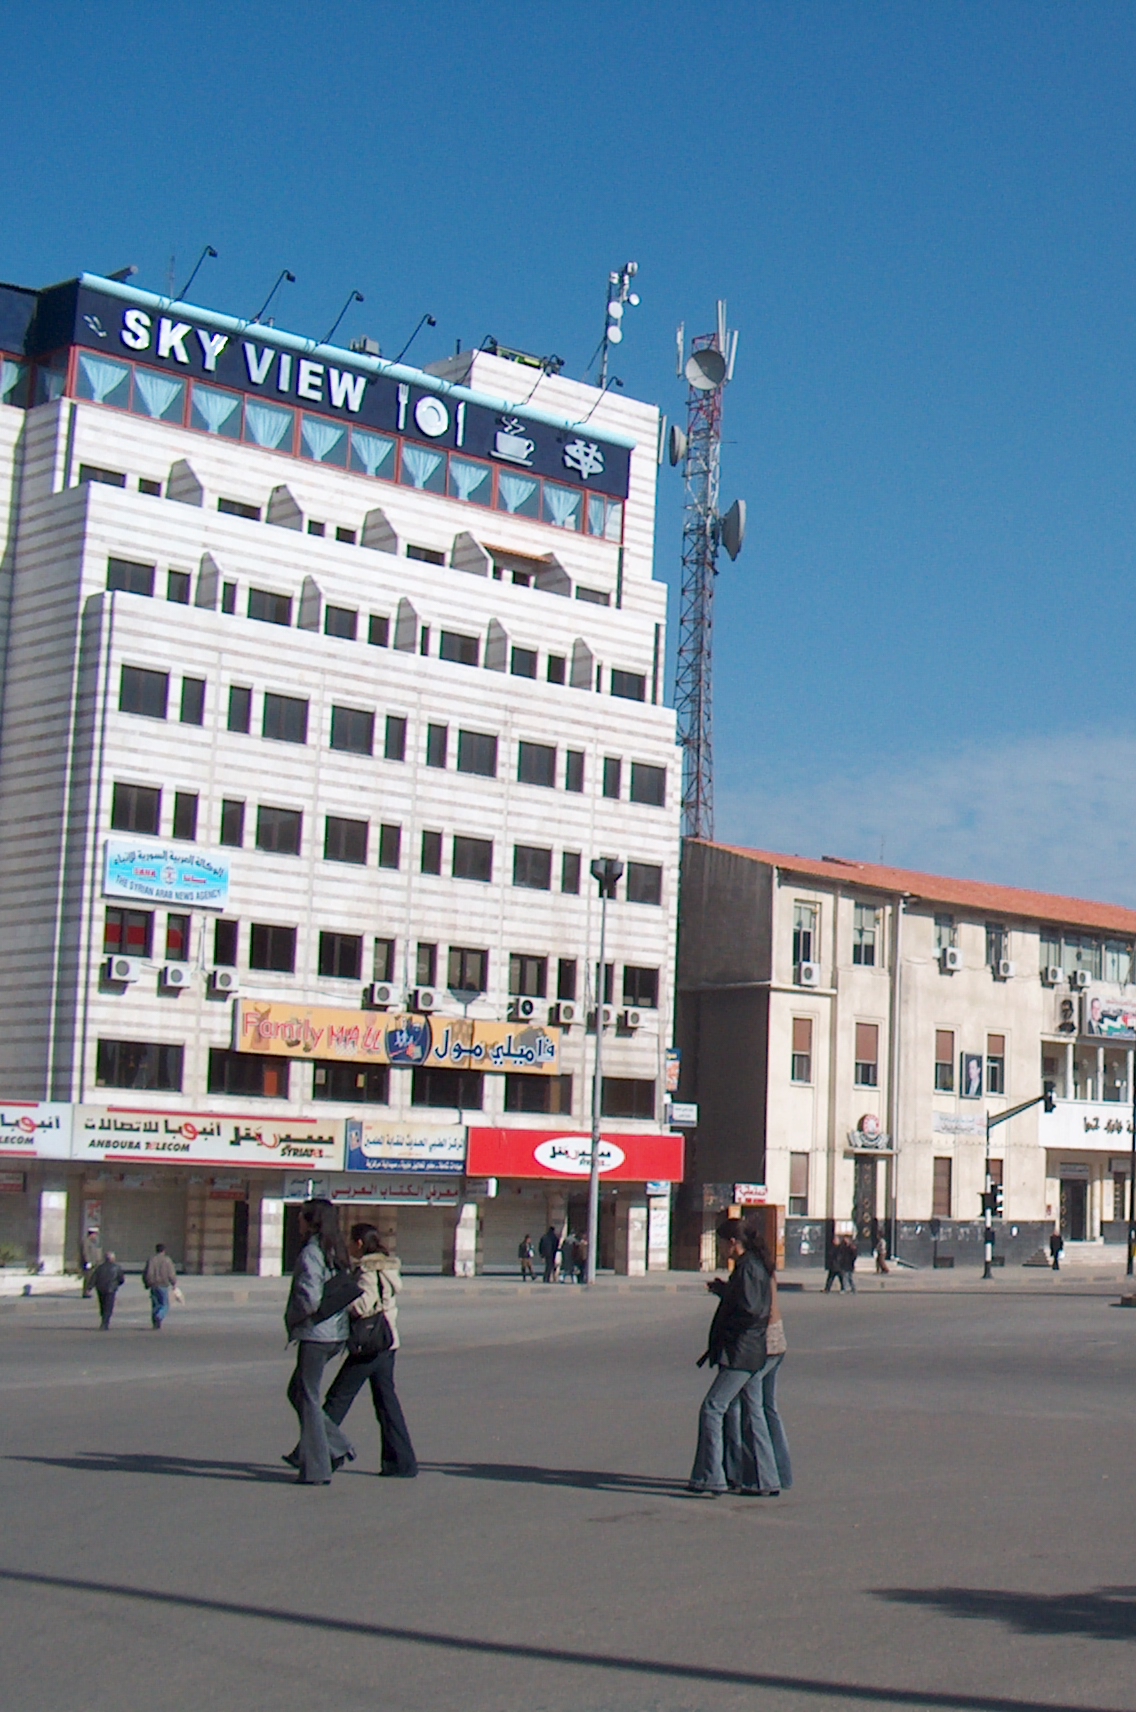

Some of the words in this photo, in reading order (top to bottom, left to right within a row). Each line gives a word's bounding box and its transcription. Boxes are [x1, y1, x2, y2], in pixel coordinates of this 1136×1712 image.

[120, 308, 229, 372] SKY
[243, 341, 368, 413] VIEW
[170, 850, 193, 866] العربية
[116, 875, 127, 889] THE
[129, 879, 154, 896] SYRIAN
[156, 888, 173, 899] ARAB
[175, 891, 194, 900] NEWS
[196, 888, 221, 900] AGENCY
[243, 1011, 324, 1049] Family
[327, 1024, 382, 1050] MALL
[434, 1026, 483, 1061] مول
[490, 1033, 556, 1065] فاميلي
[88, 1138, 141, 1150] ANBOUBA
[144, 1141, 191, 1152] TELECOM
[331, 1184, 377, 1199] العربي
[380, 1184, 423, 1199] الكتاب
